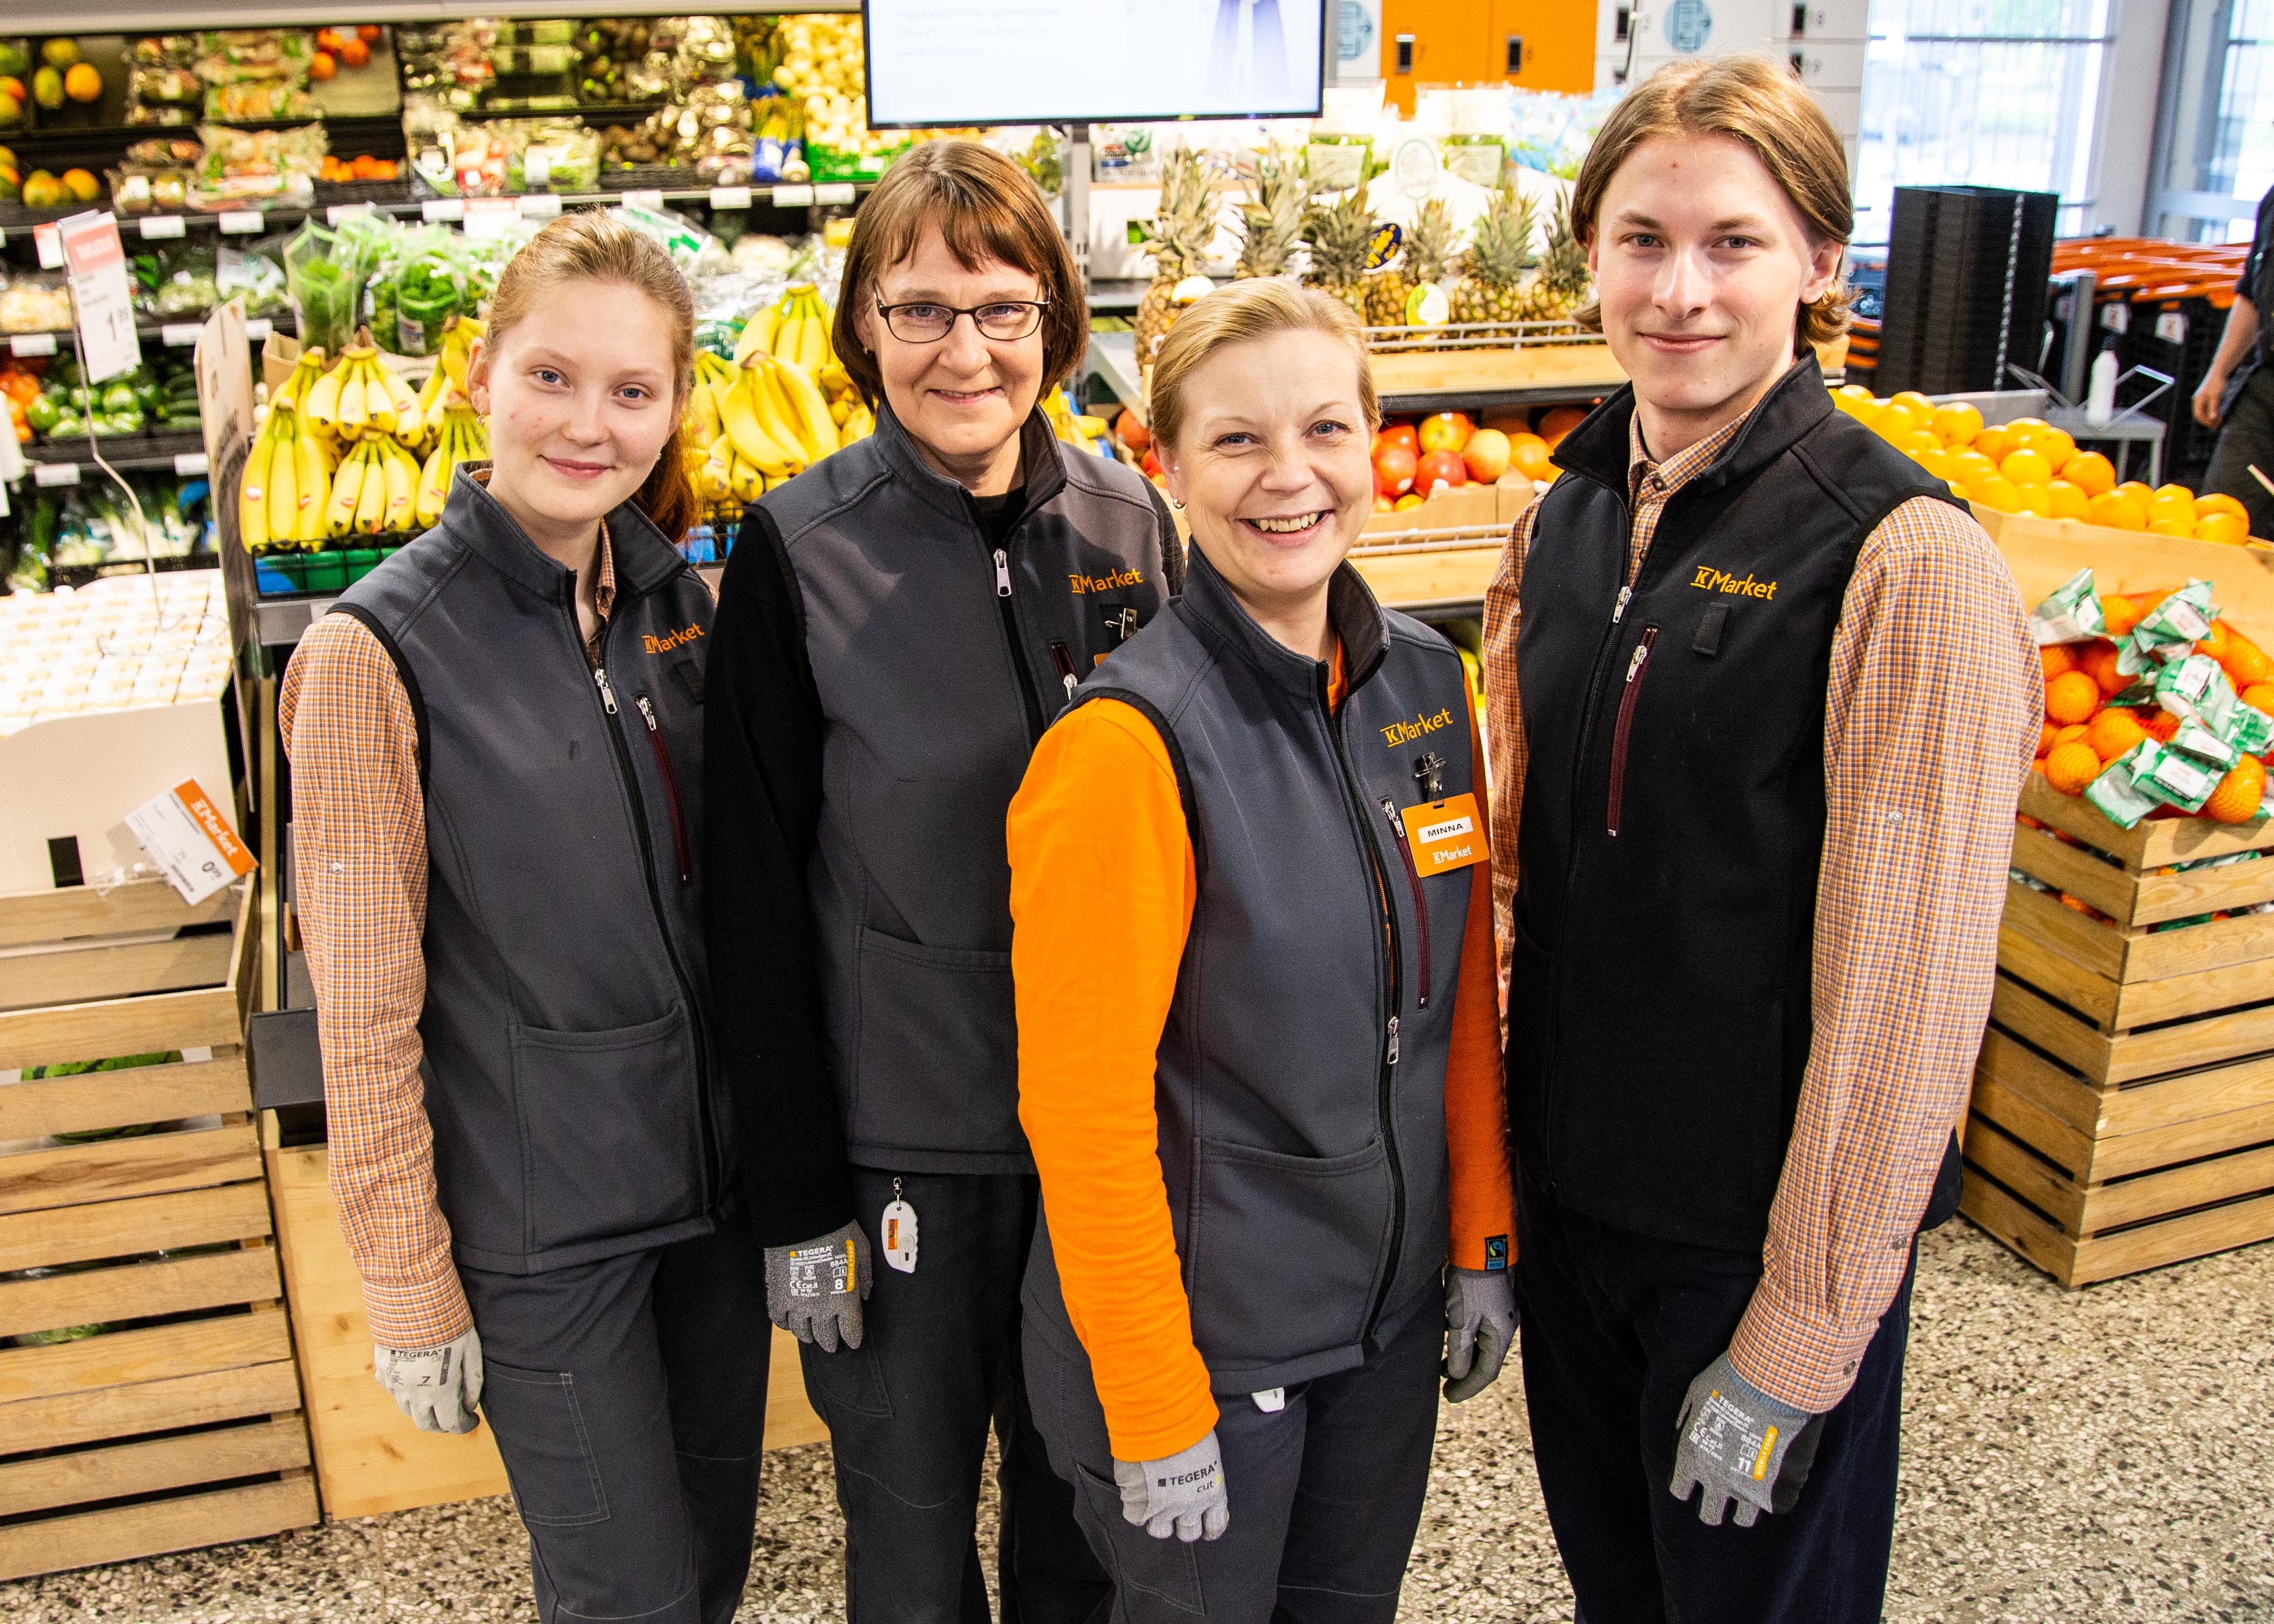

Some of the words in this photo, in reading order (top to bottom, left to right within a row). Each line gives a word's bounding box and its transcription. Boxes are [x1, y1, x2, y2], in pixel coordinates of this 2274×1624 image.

[1427, 823, 1463, 837] MINNA
[830, 1258, 848, 1268] 884A
[835, 1278, 844, 1290] 8
[1738, 1457, 1752, 1473] 11
[1197, 1481, 1214, 1492] cut
